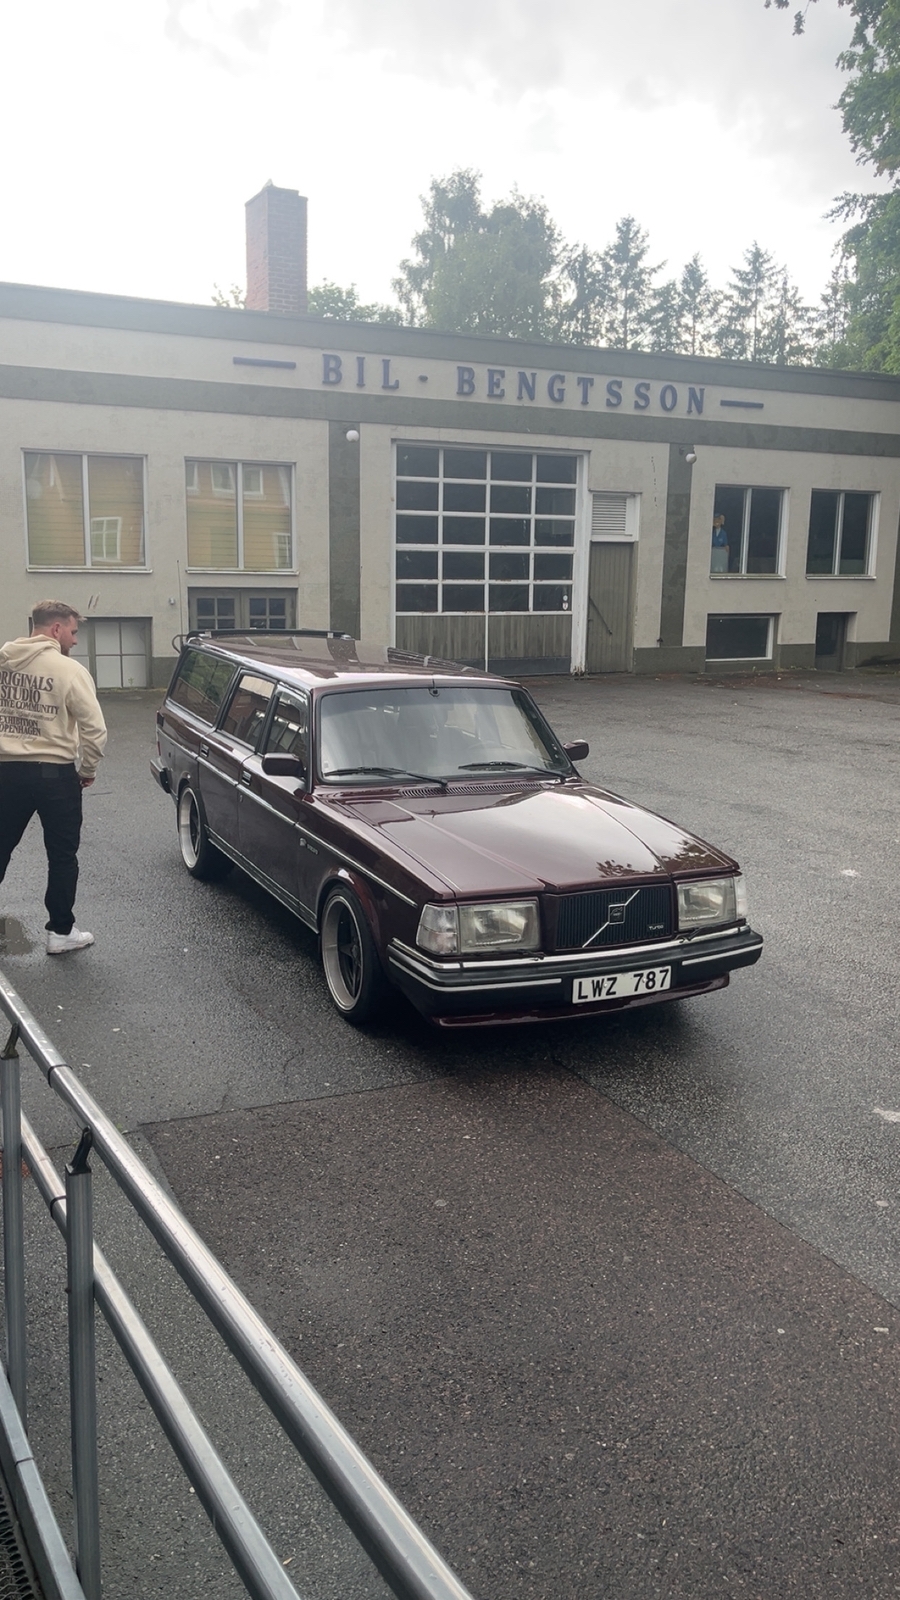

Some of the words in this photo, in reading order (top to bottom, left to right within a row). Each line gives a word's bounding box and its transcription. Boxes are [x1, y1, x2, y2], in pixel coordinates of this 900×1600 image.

[322, 354, 399, 389] BIL
[456, 366, 705, 414] BENGTSSON
[0, 671, 54, 692] RIGINALS
[1, 685, 41, 704] STUDIO
[15, 701, 59, 715] COMMUNITY
[578, 977, 618, 1000] LWZ
[633, 968, 669, 992] 787
